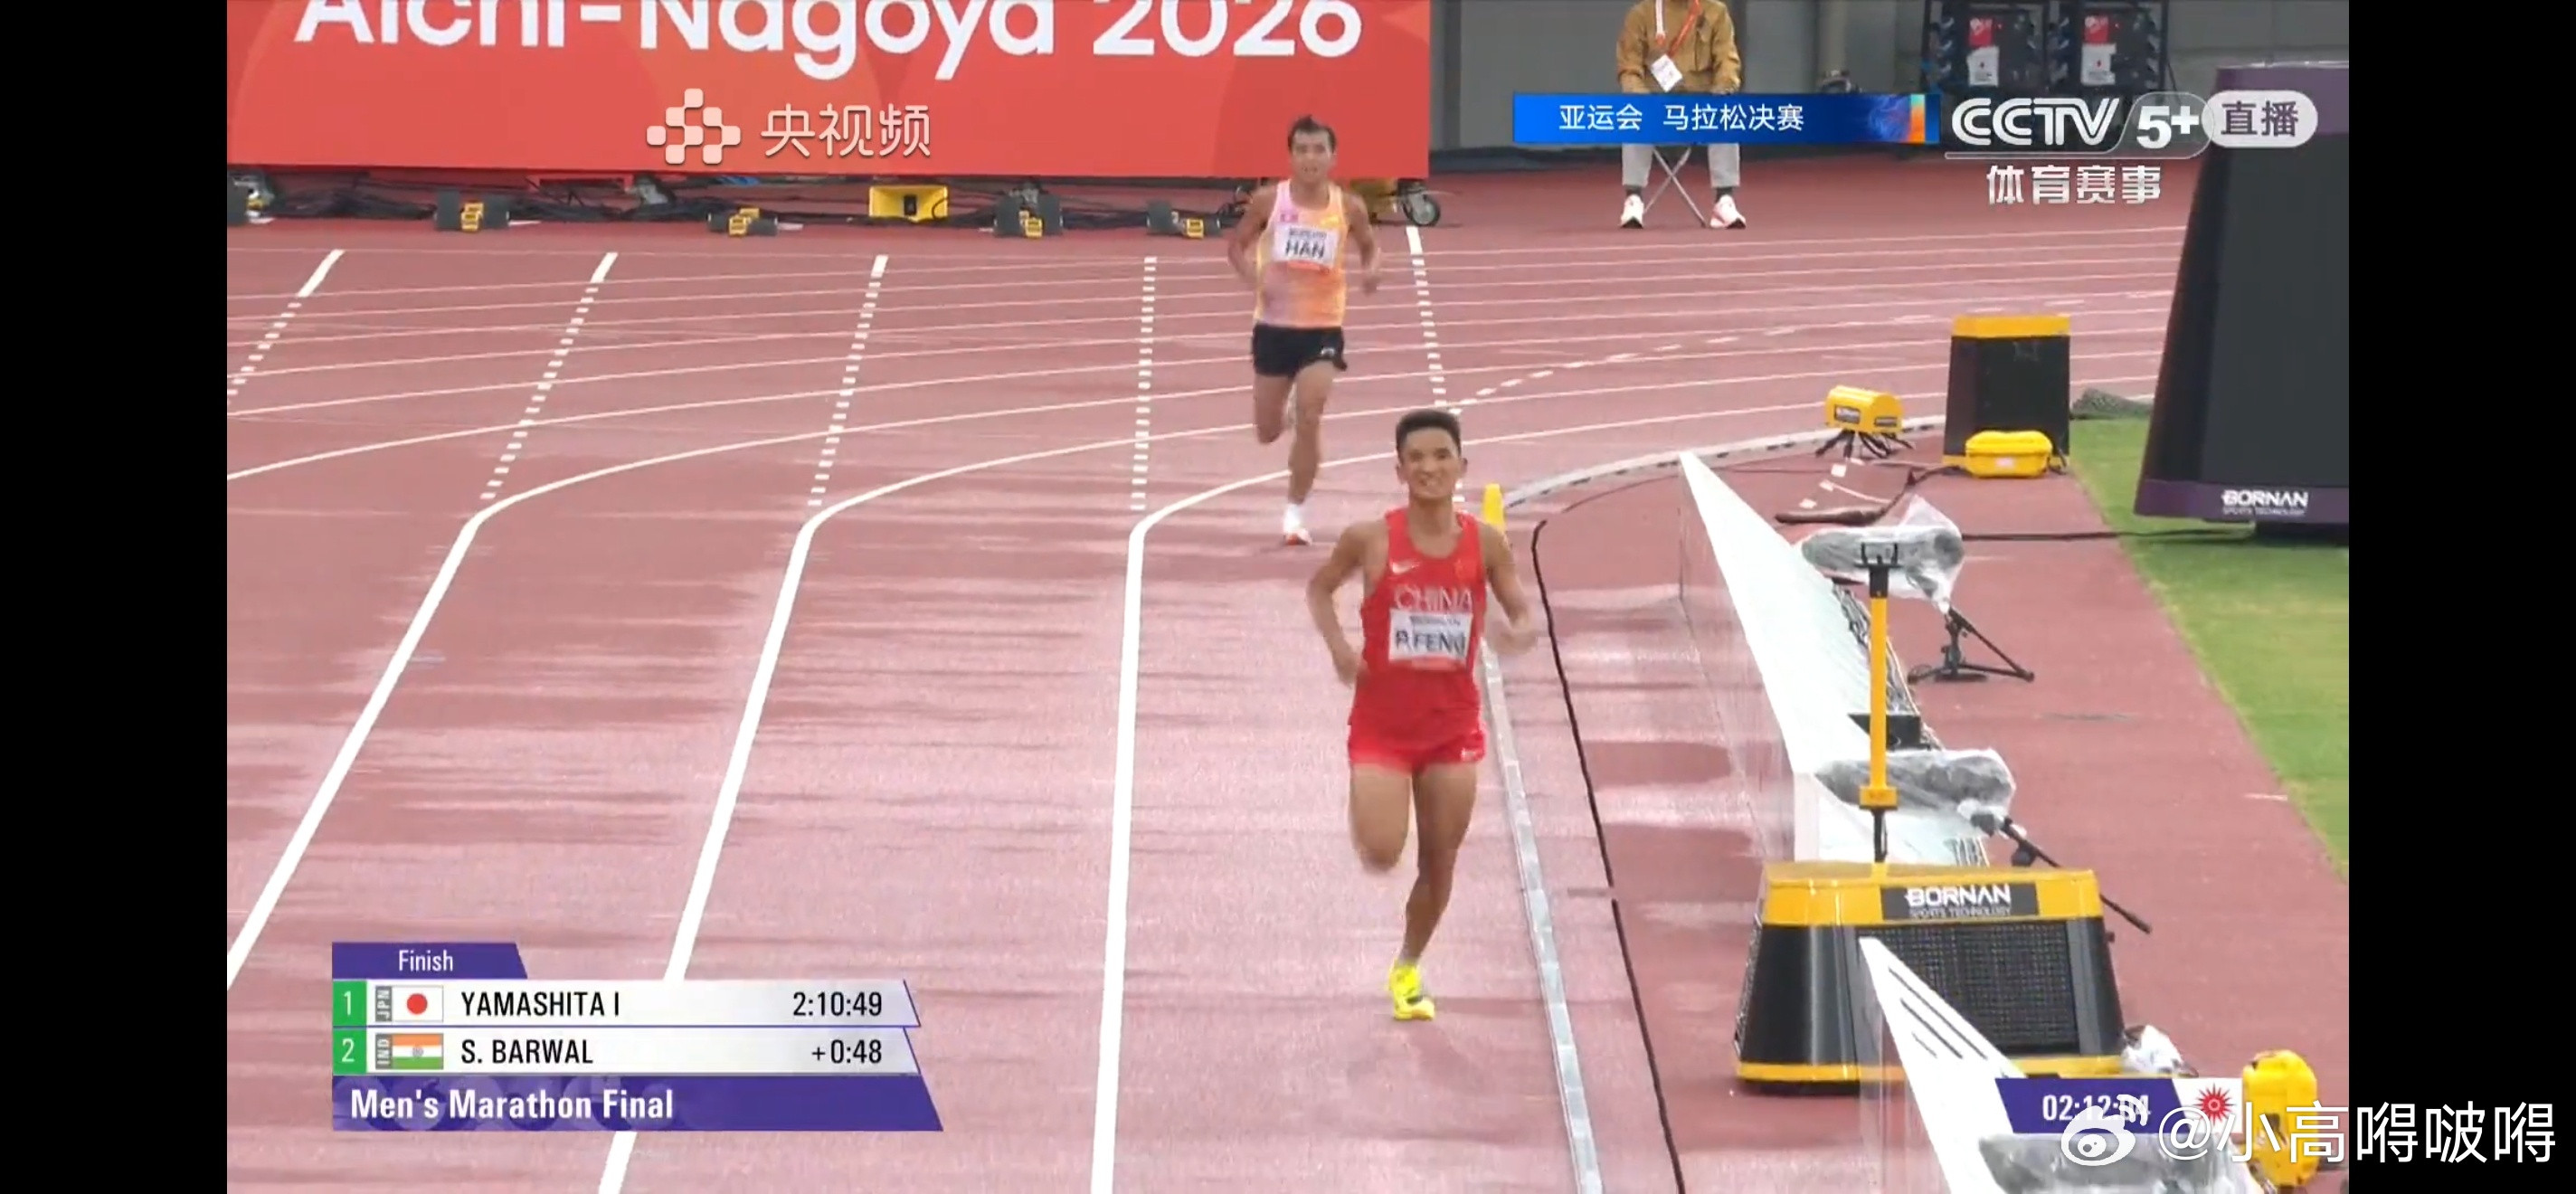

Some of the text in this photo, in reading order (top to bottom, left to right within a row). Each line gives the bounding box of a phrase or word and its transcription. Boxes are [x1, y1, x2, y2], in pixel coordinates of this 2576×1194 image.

[294, 0, 1362, 80] Aichi-Nagoya 2026
[1285, 238, 1326, 259] HAN
[2221, 489, 2309, 507] BORNAN
[1394, 584, 1473, 612] CHINA
[1904, 883, 2012, 907] BORNAN
